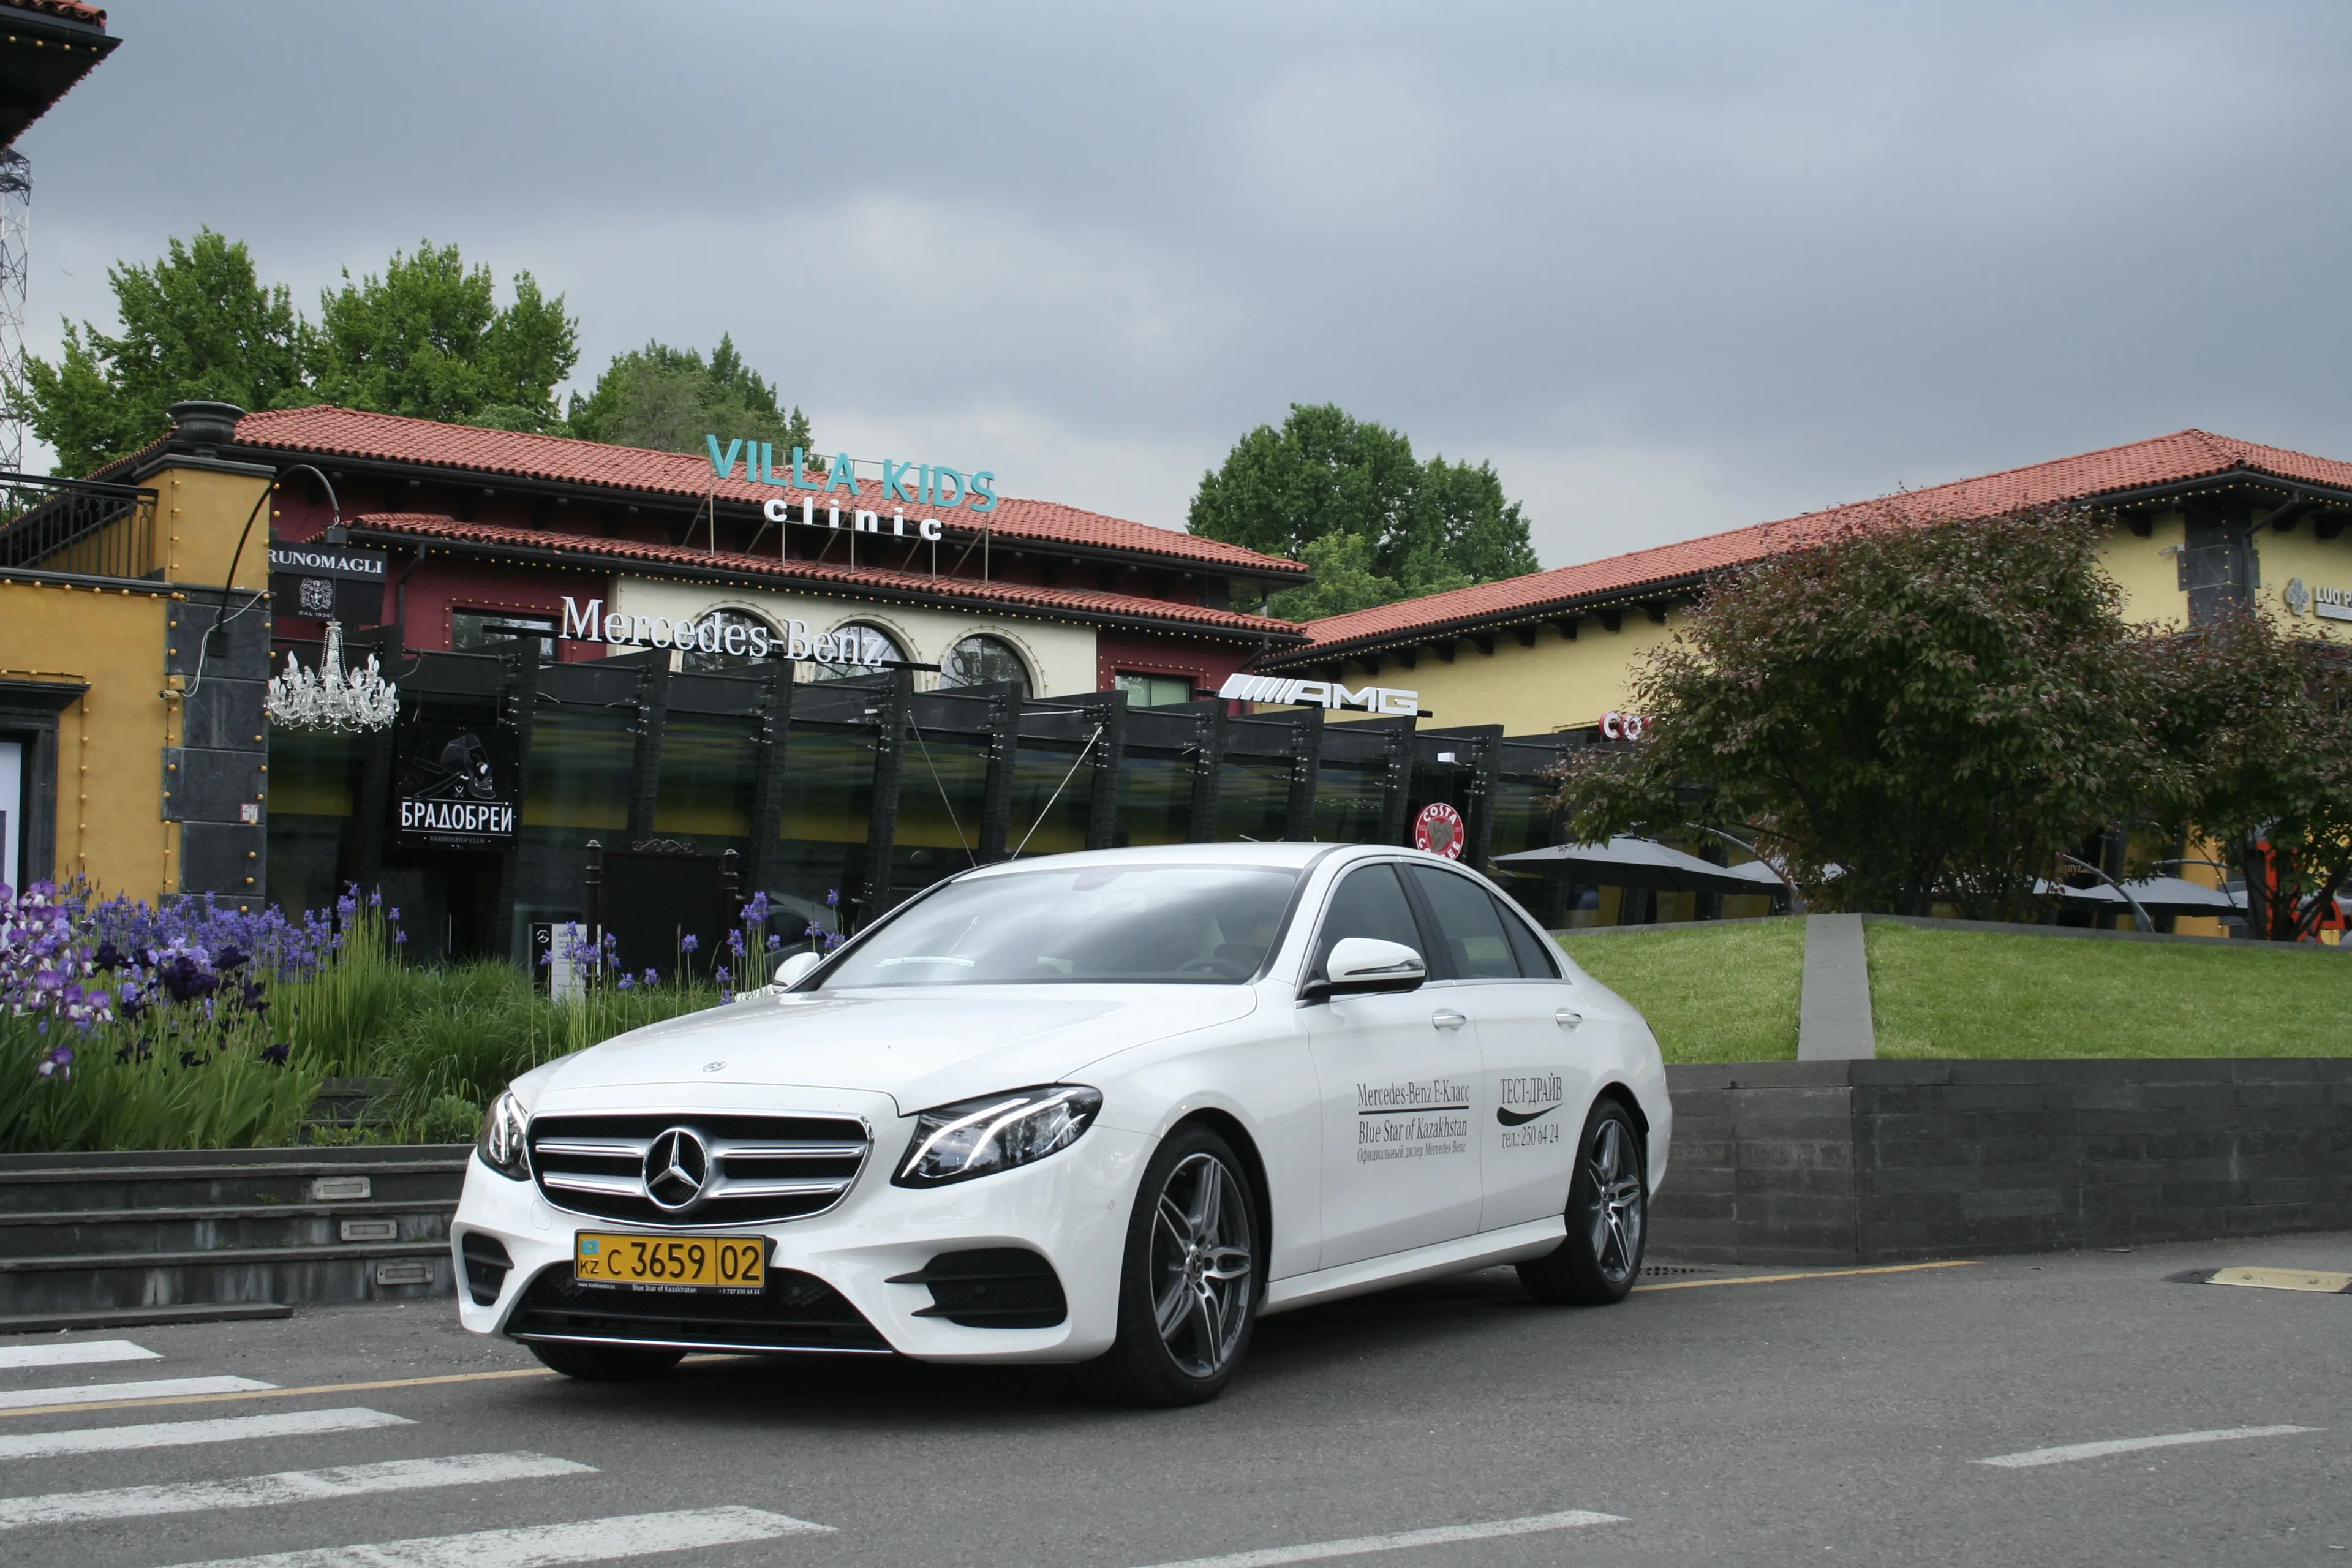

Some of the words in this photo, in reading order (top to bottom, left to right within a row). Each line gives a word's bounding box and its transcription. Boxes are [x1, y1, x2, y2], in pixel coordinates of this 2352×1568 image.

[706, 434, 861, 495] VILLA
[883, 459, 998, 513] KIDS
[764, 497, 943, 541] clinic
[2315, 586, 2340, 605] LUO
[558, 596, 884, 666] Mercedes-Benz
[1284, 679, 1419, 717] AMG
[402, 801, 513, 832] БРАДОБРЕЙ
[1423, 805, 1457, 825] COSTA
[1357, 1082, 1431, 1106] Mercedes-Benz
[1500, 1071, 1562, 1107] ТЕСТ-ДРАЙВ
[1358, 1121, 1381, 1144] Blue
[1383, 1120, 1403, 1142] Star
[1405, 1118, 1416, 1140] of
[1417, 1117, 1467, 1139] Kazakhstan
[1521, 1126, 1536, 1146] 250
[1538, 1124, 1547, 1144] 64
[1550, 1123, 1559, 1143] 24
[1357, 1145, 1404, 1164] Официальный
[1405, 1146, 1423, 1159] дилер
[1425, 1140, 1466, 1156] Mercedes-Benz
[580, 1259, 600, 1275] KZ
[607, 1248, 622, 1275] C
[631, 1241, 706, 1279] 3659
[720, 1244, 760, 1281] 02
